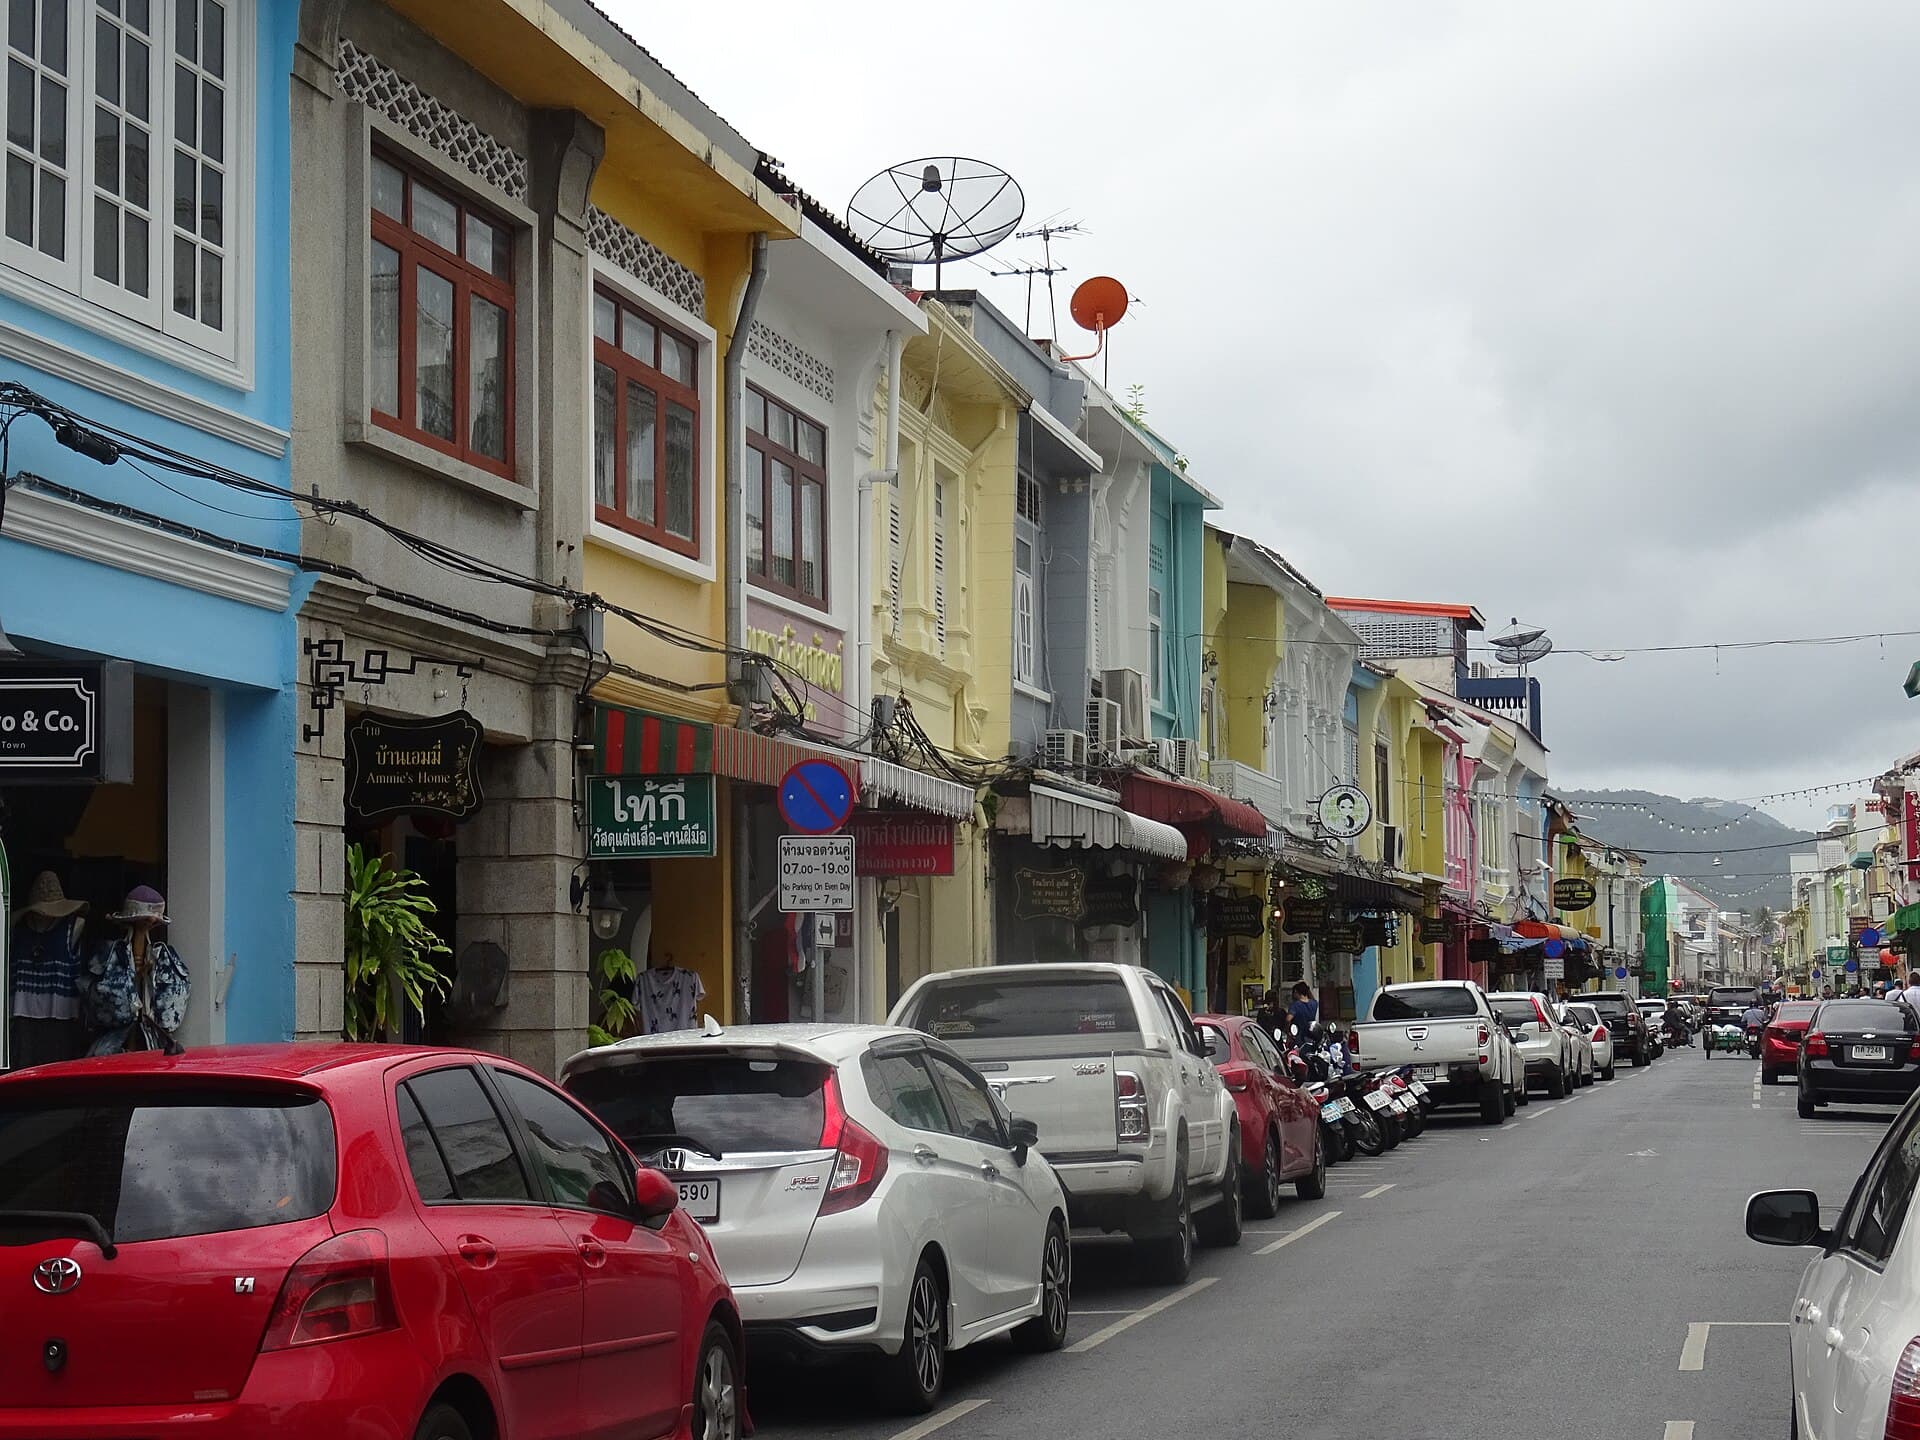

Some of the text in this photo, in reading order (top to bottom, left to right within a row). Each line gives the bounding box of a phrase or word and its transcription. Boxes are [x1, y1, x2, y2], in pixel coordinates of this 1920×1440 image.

[21, 710, 39, 732] &
[44, 710, 80, 732] Co.
[365, 727, 380, 736] 110
[2, 741, 26, 749] Town
[366, 771, 451, 784] Ammie's Home
[782, 841, 851, 861] ห้ามจอดวันคู่
[783, 862, 850, 875] 07.00-19.00
[782, 883, 791, 891] No
[792, 882, 813, 892] Parking
[814, 883, 823, 891] On
[839, 883, 851, 892] Day
[790, 894, 797, 904] 7
[823, 894, 830, 904] 7
[831, 898, 843, 906] pm
[790, 1175, 820, 1186] RS
[679, 1184, 709, 1200] 590
